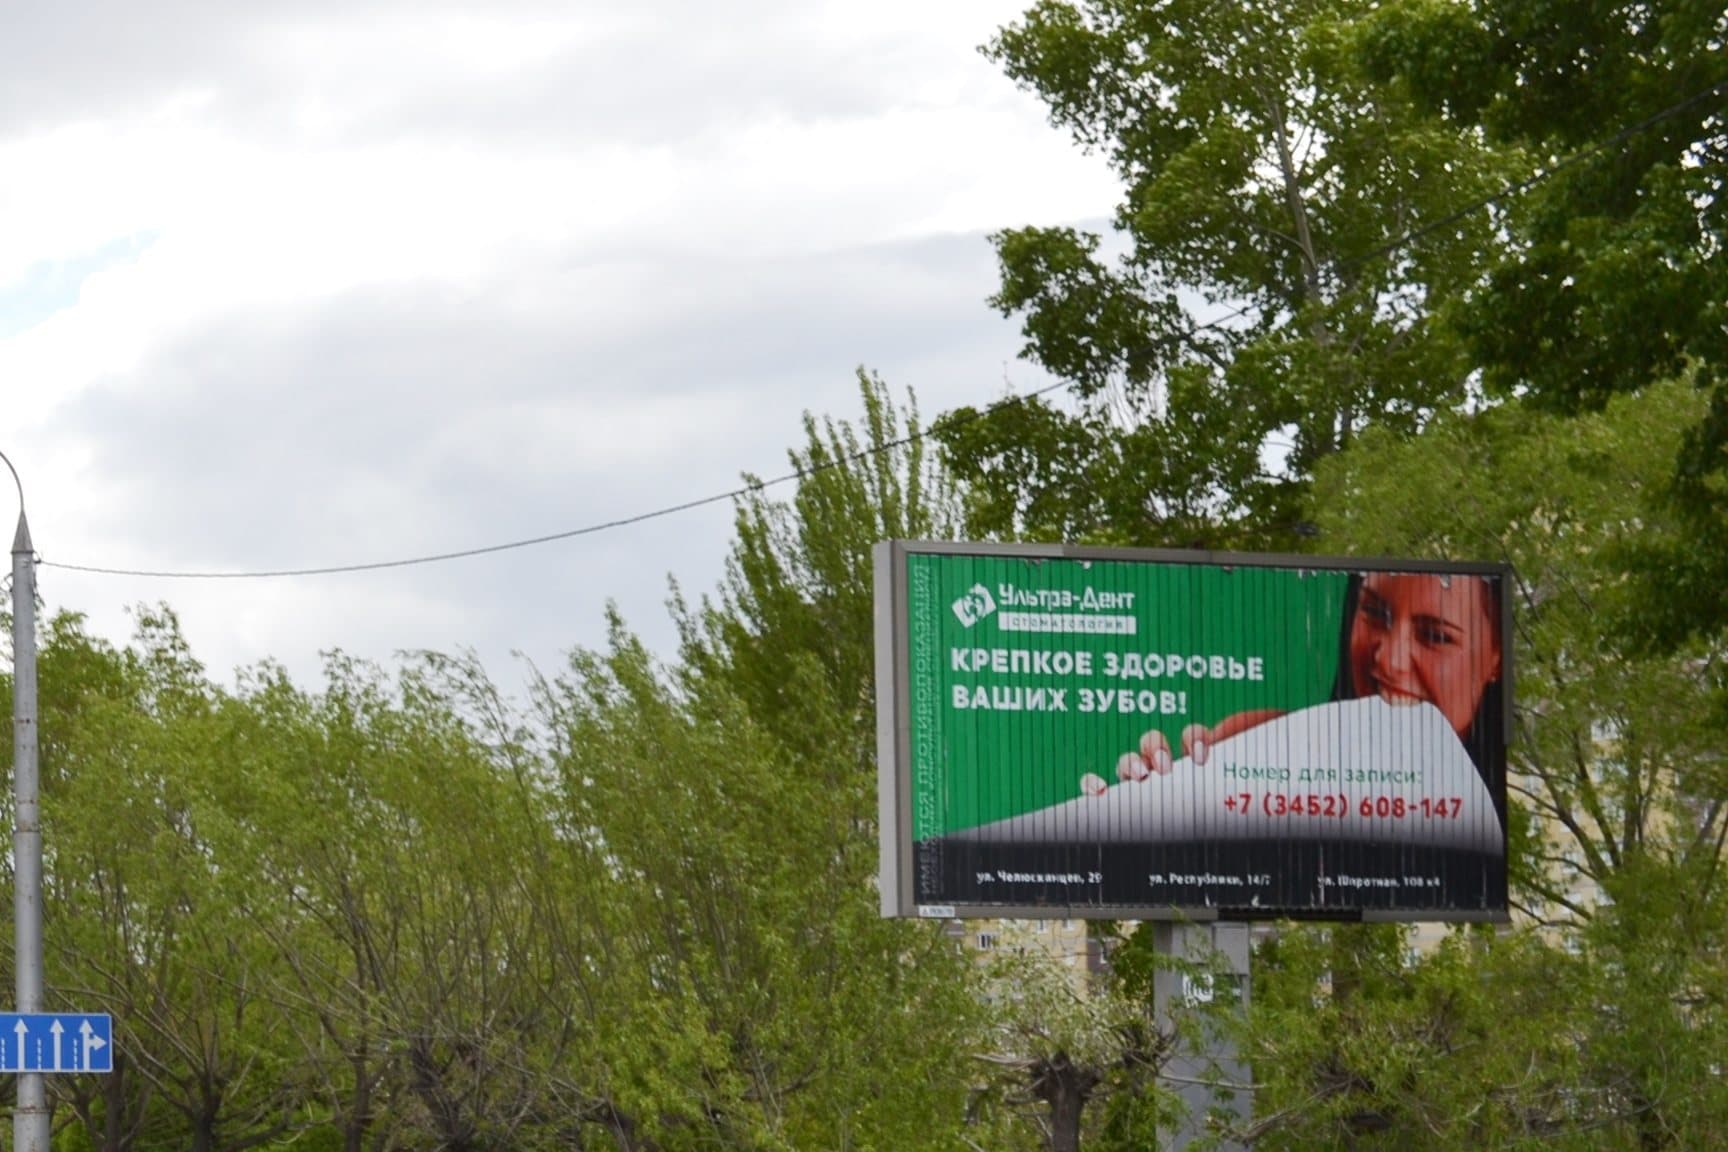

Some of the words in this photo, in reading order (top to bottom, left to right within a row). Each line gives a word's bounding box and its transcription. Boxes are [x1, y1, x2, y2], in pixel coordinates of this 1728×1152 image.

[998, 583, 1135, 612] Ультра-Дент
[951, 648, 1093, 676] КРЕПКОЕ
[1103, 653, 1264, 681] ЗДОРОВЬЕ
[952, 685, 1069, 712] ВАШИХ
[1078, 688, 1187, 715] ЗУБОВ!
[1223, 762, 1291, 783] Номер
[1298, 768, 1337, 782] для
[1344, 769, 1422, 784] записи:
[1224, 793, 1252, 814] +7
[1263, 793, 1348, 818] (3452)
[1359, 796, 1463, 819] 608-147
